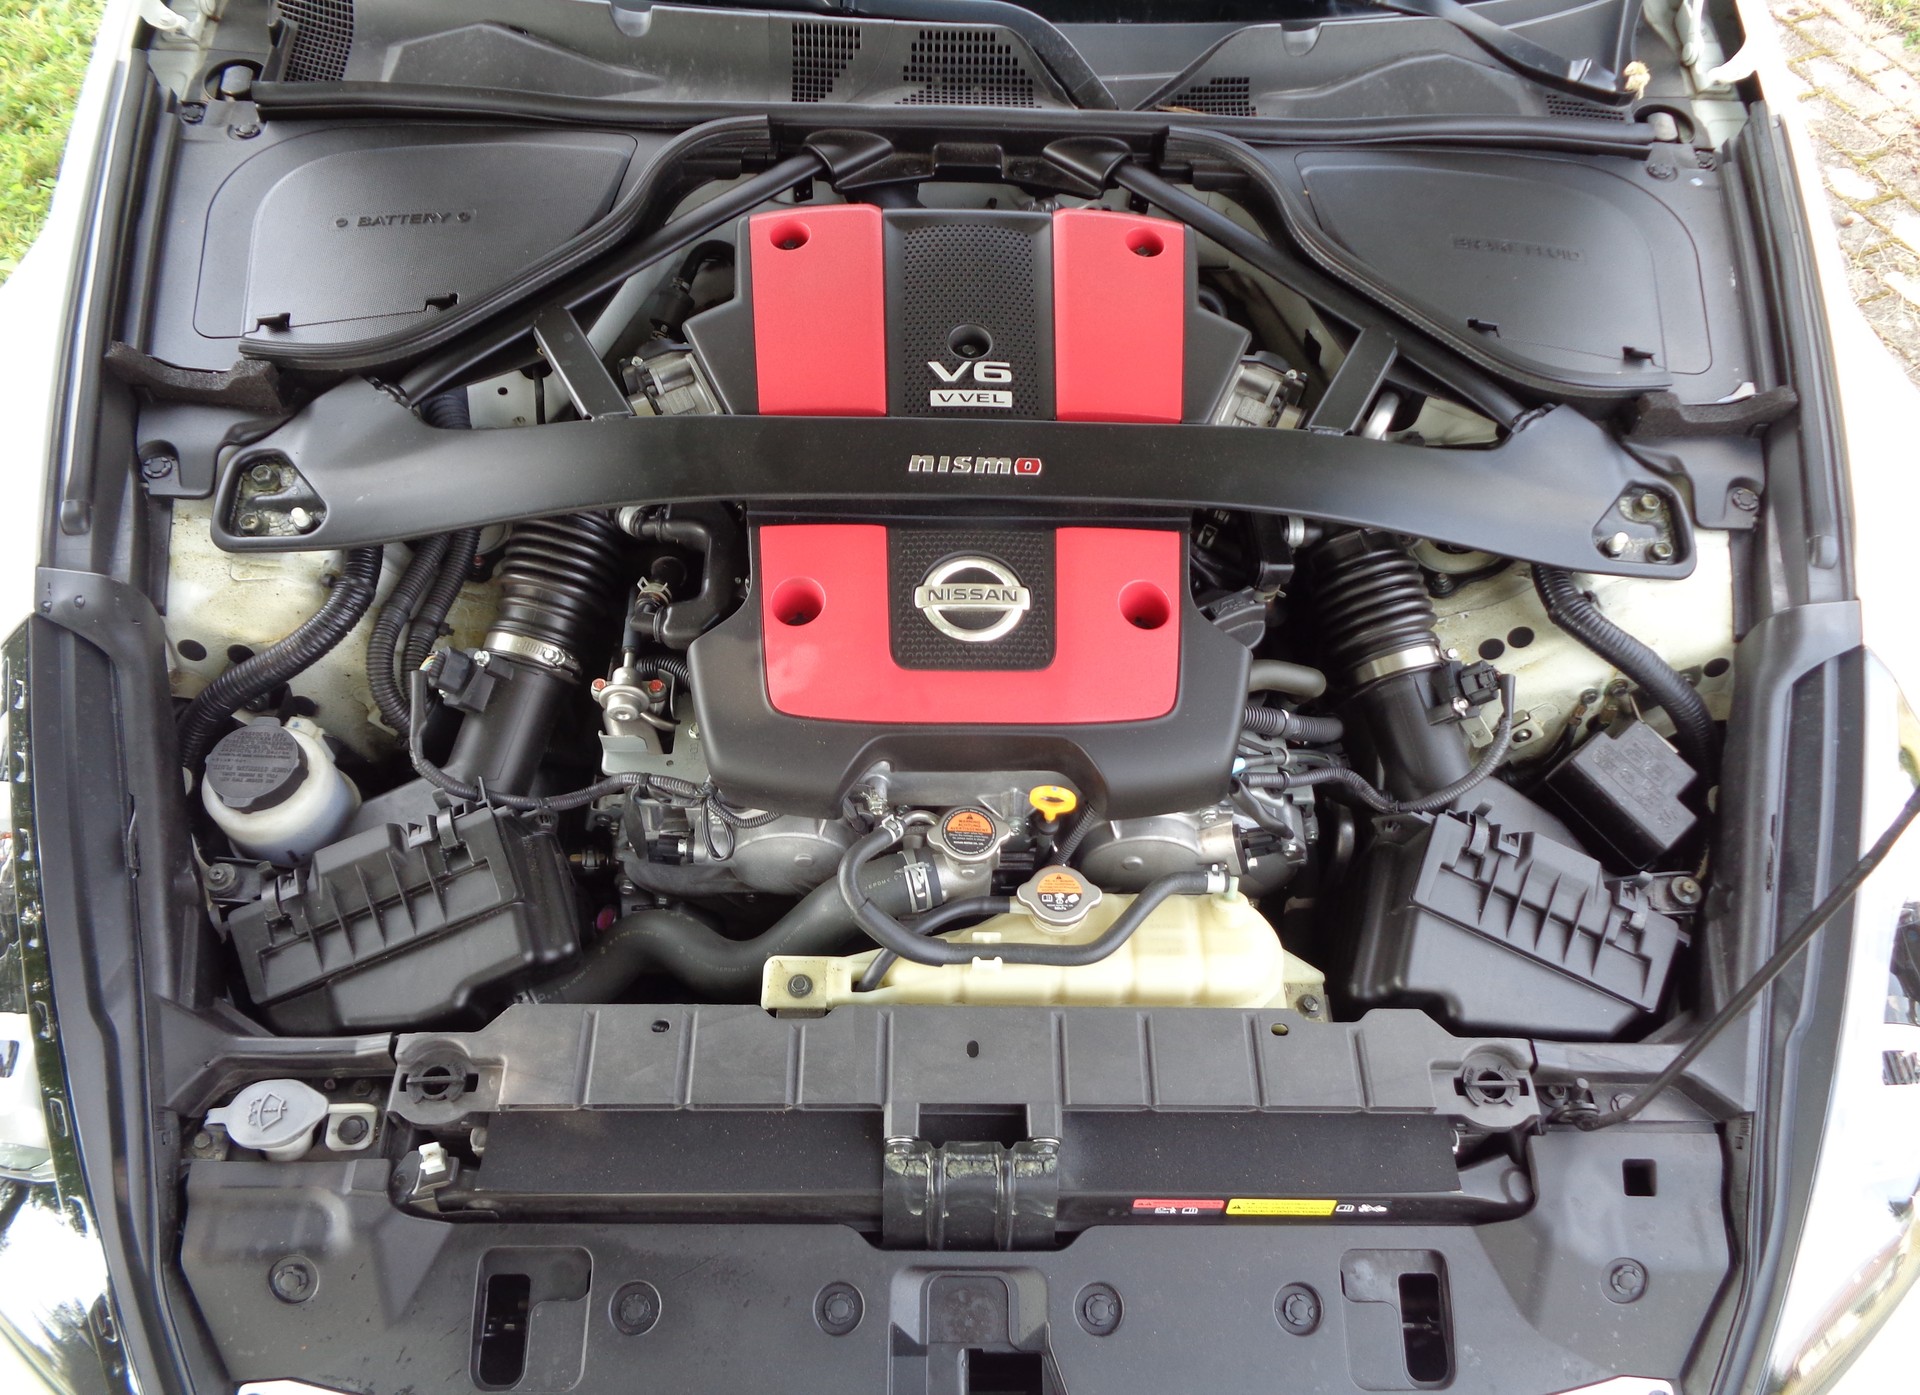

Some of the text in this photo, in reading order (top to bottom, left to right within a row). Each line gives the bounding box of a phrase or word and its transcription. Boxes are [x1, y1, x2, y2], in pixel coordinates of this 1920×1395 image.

[357, 212, 451, 227] BATTERY
[927, 361, 1012, 382] V6
[937, 393, 1005, 404] VVEL
[928, 588, 1017, 602] NISSAN
